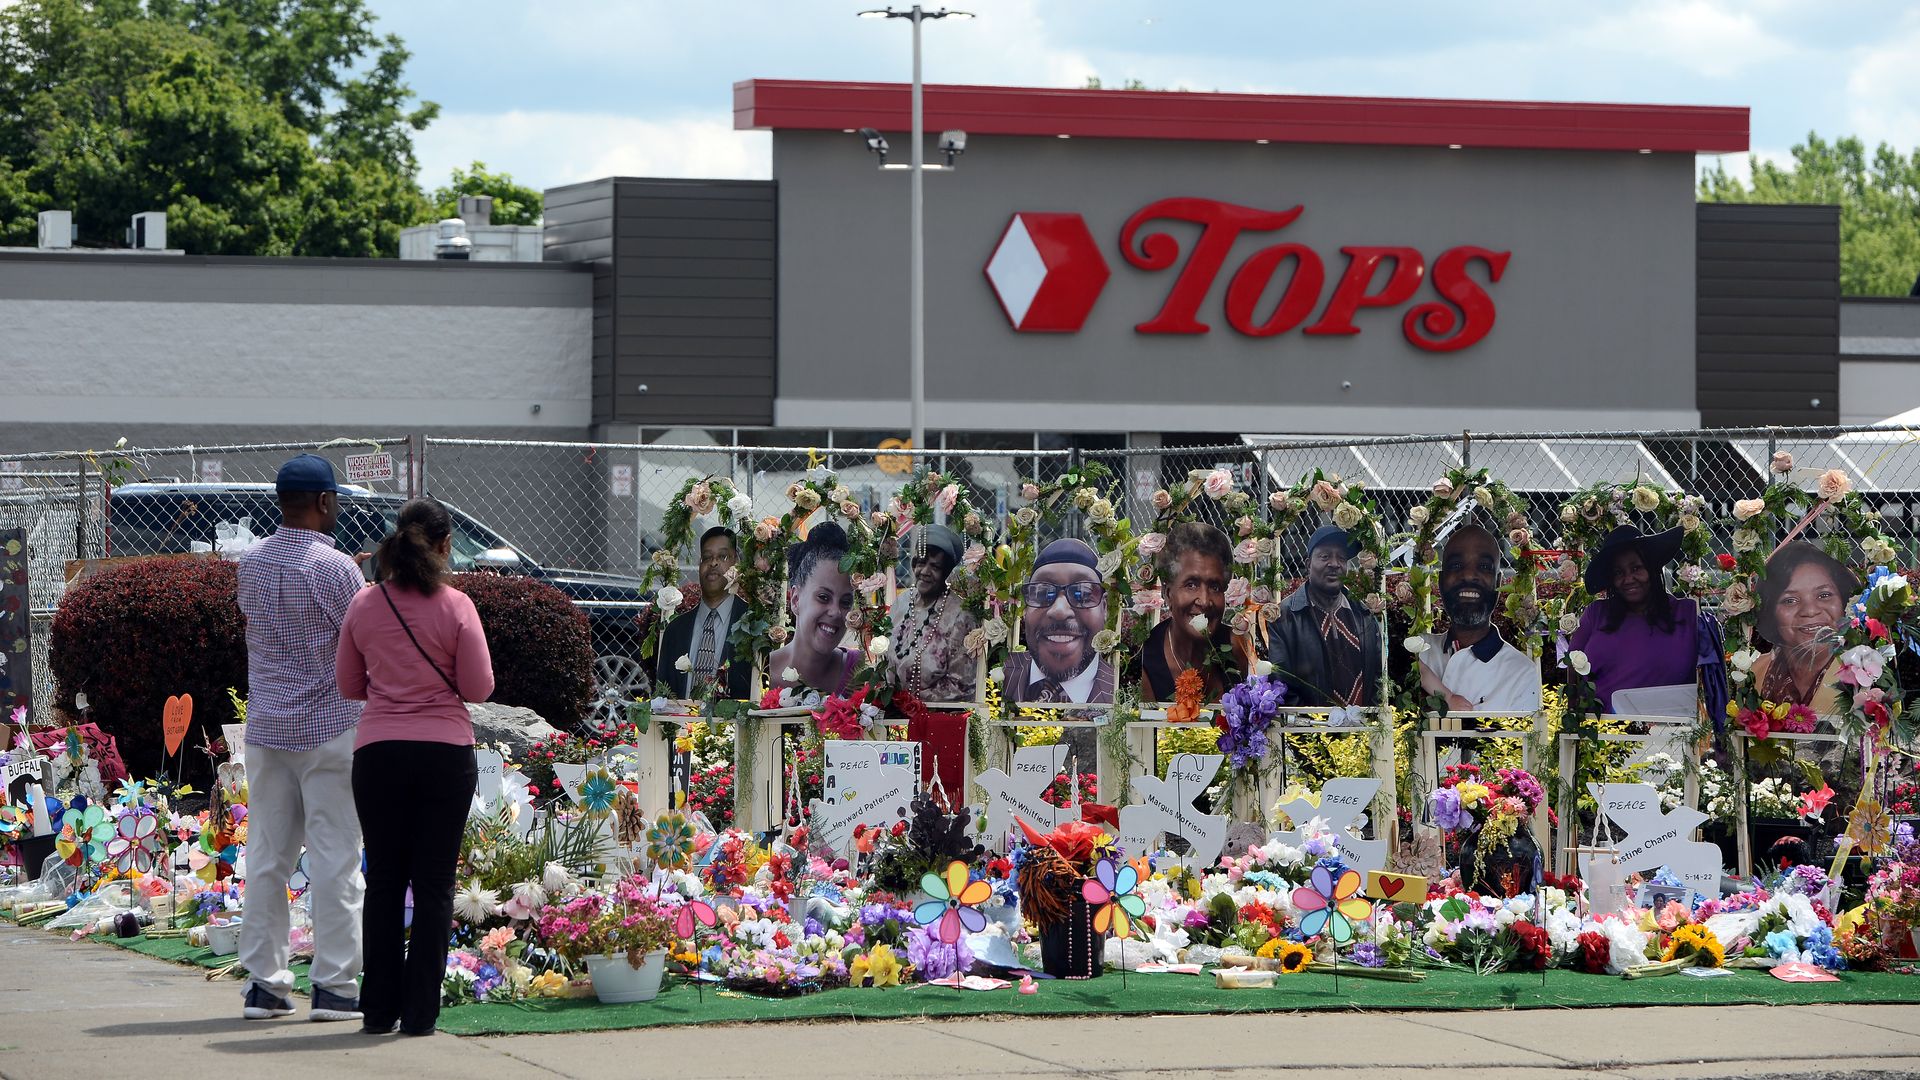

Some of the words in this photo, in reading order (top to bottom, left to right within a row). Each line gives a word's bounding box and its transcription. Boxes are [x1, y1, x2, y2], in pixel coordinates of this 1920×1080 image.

[348, 454, 390, 467] WOODSMITH
[8, 758, 43, 777] BUFFAL
[478, 765, 496, 774] EACE
[839, 760, 869, 770] PEACE
[1016, 763, 1048, 774] PEACE
[1171, 771, 1203, 783] PEACE
[1326, 794, 1360, 805] PEACE
[832, 807, 864, 831] Heyward
[864, 787, 899, 812] Patterson
[1000, 791, 1018, 807] Ruth
[1018, 801, 1051, 828] Whitfield
[1608, 801, 1647, 810] PEACE
[1147, 794, 1174, 816] Margus
[1174, 811, 1207, 838] Morrison
[1124, 836, 1146, 844] 5-14-22
[1644, 829, 1678, 849] Chaney
[1684, 873, 1713, 881] 5-14-22
